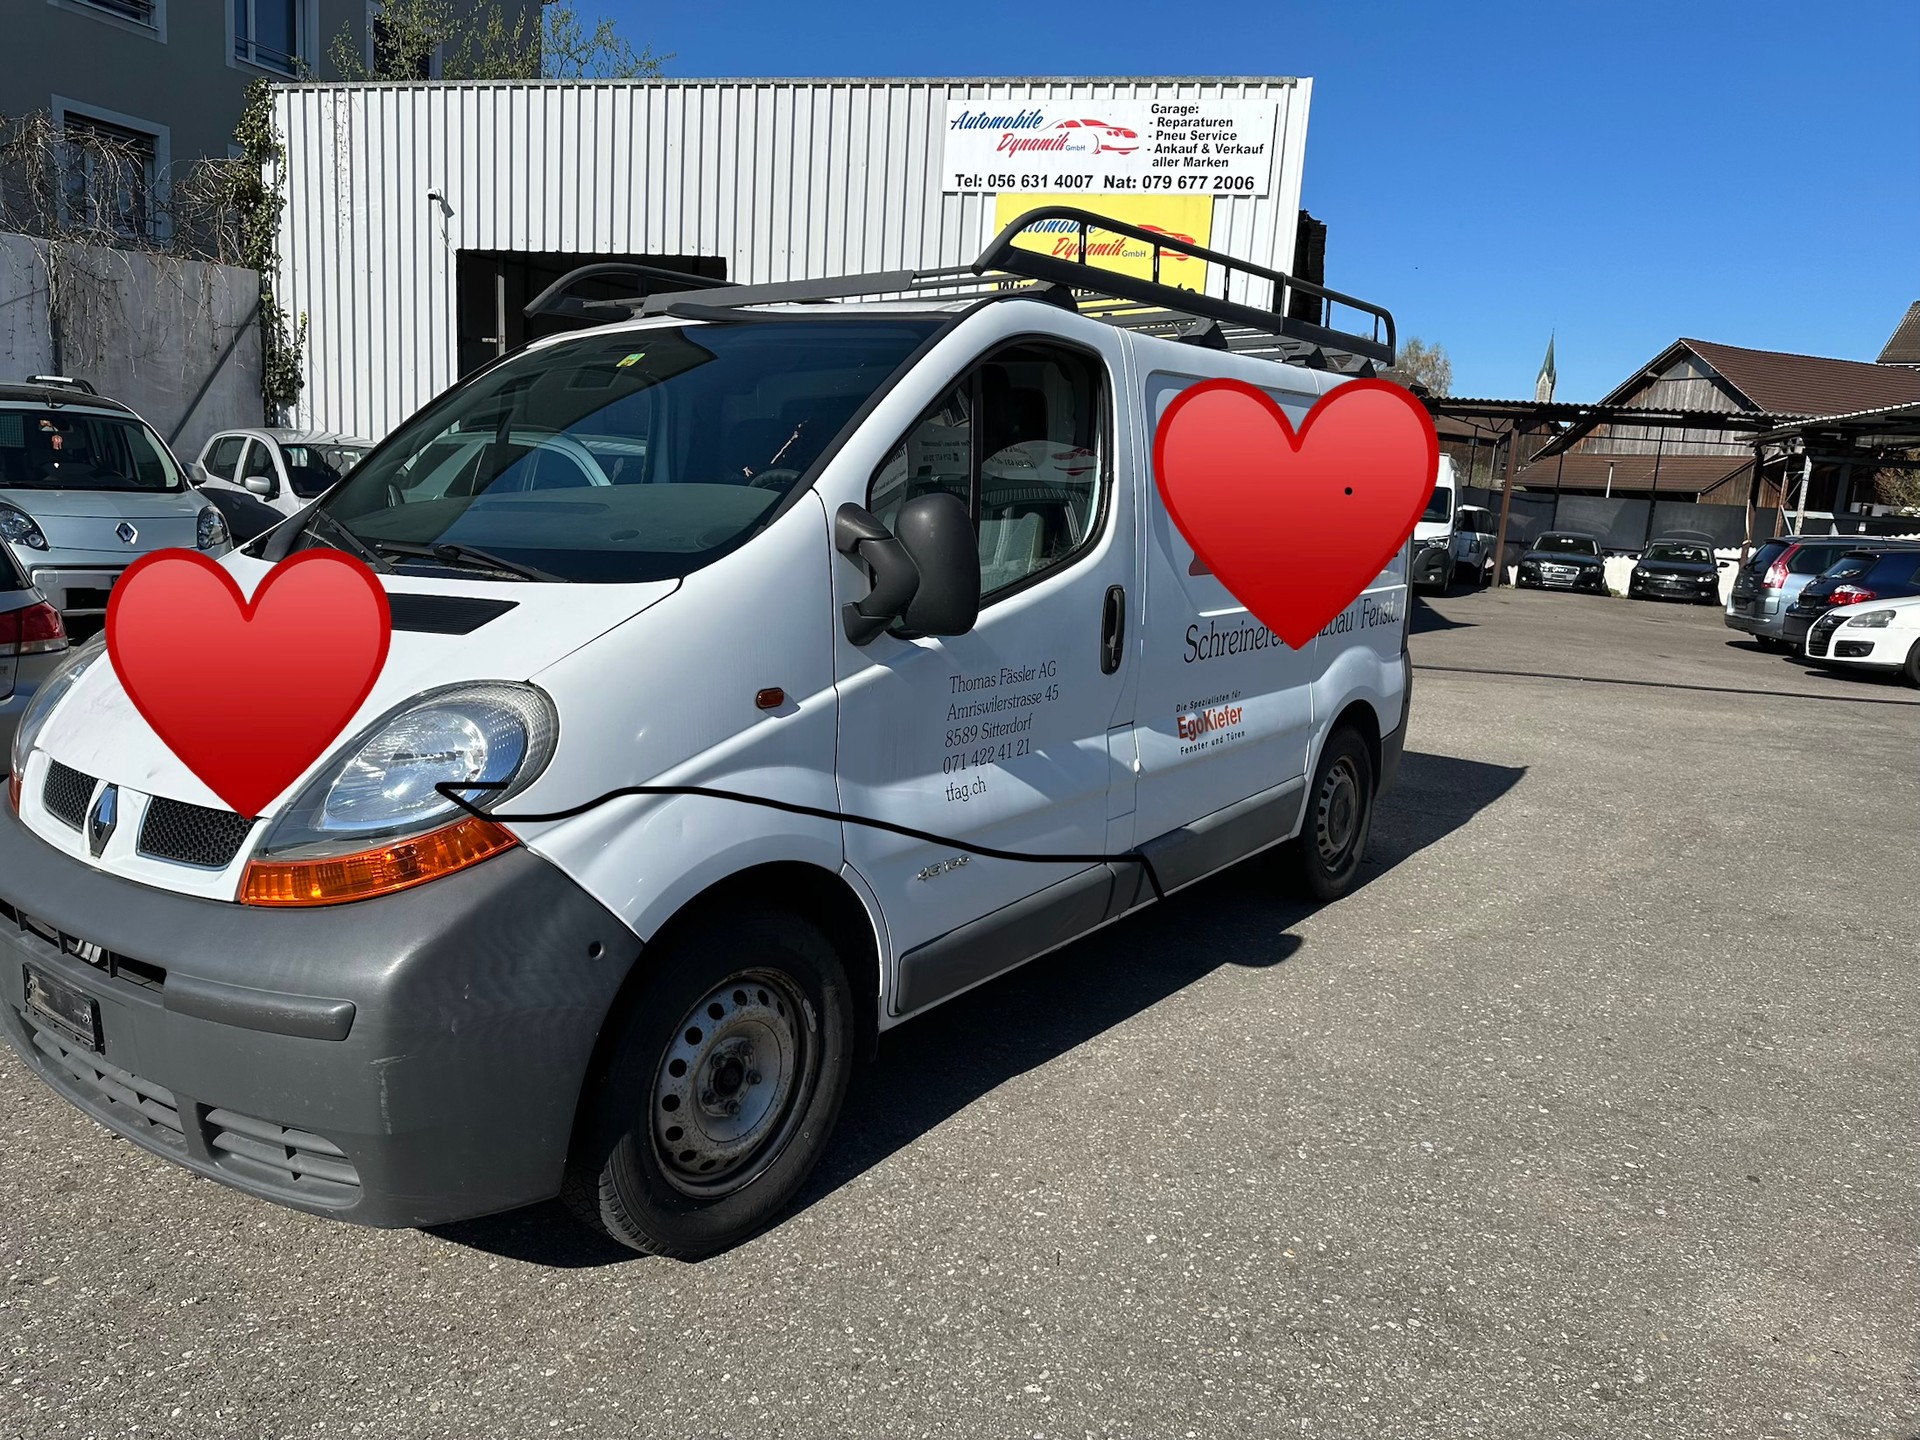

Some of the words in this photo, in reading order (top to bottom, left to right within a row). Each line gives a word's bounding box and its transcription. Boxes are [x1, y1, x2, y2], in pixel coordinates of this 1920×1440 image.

[950, 109, 1044, 130] Automobile
[1151, 103, 1199, 116] Garage:
[1156, 130, 1187, 141] Pneu
[1190, 130, 1237, 141] Service
[1157, 117, 1233, 130] Reparaturen
[997, 132, 1070, 158] Dynamik
[1066, 144, 1085, 152] GmbH
[1154, 143, 1198, 155] Ankauf
[1201, 144, 1210, 155] &
[1215, 143, 1264, 155] Verkauf
[1152, 157, 1179, 167] aller
[1183, 157, 1229, 168] Marken
[955, 174, 983, 188] Tel:
[987, 174, 1016, 188] 056
[1021, 174, 1048, 188] 631
[1054, 174, 1093, 189] 4007
[1103, 175, 1137, 189] Nat:
[1142, 175, 1172, 189] 079
[1177, 175, 1208, 189] 677
[1214, 175, 1255, 190] 2006
[1122, 250, 1146, 258] GmbH
[1184, 620, 1284, 663] Schreinere
[949, 671, 996, 694] Thomas
[1000, 665, 1036, 686] Fässler
[1038, 660, 1056, 678] AG
[946, 690, 1042, 721] Amriswilerstrasse
[1044, 684, 1059, 701] 45
[1176, 703, 1187, 713] Die
[1190, 693, 1229, 710] Spezialisten
[1231, 689, 1241, 699] für
[945, 725, 978, 748] 8589
[981, 713, 1033, 741] Sitterdorf
[1177, 704, 1243, 741] EgoKiefer
[1180, 741, 1208, 756] Fenster
[1211, 735, 1223, 746] und
[1226, 730, 1245, 742] Türen
[943, 750, 966, 775] 071
[970, 745, 995, 768] 422
[999, 741, 1011, 761] 41
[1016, 738, 1030, 757] 21
[945, 776, 987, 802] tfag.ch
